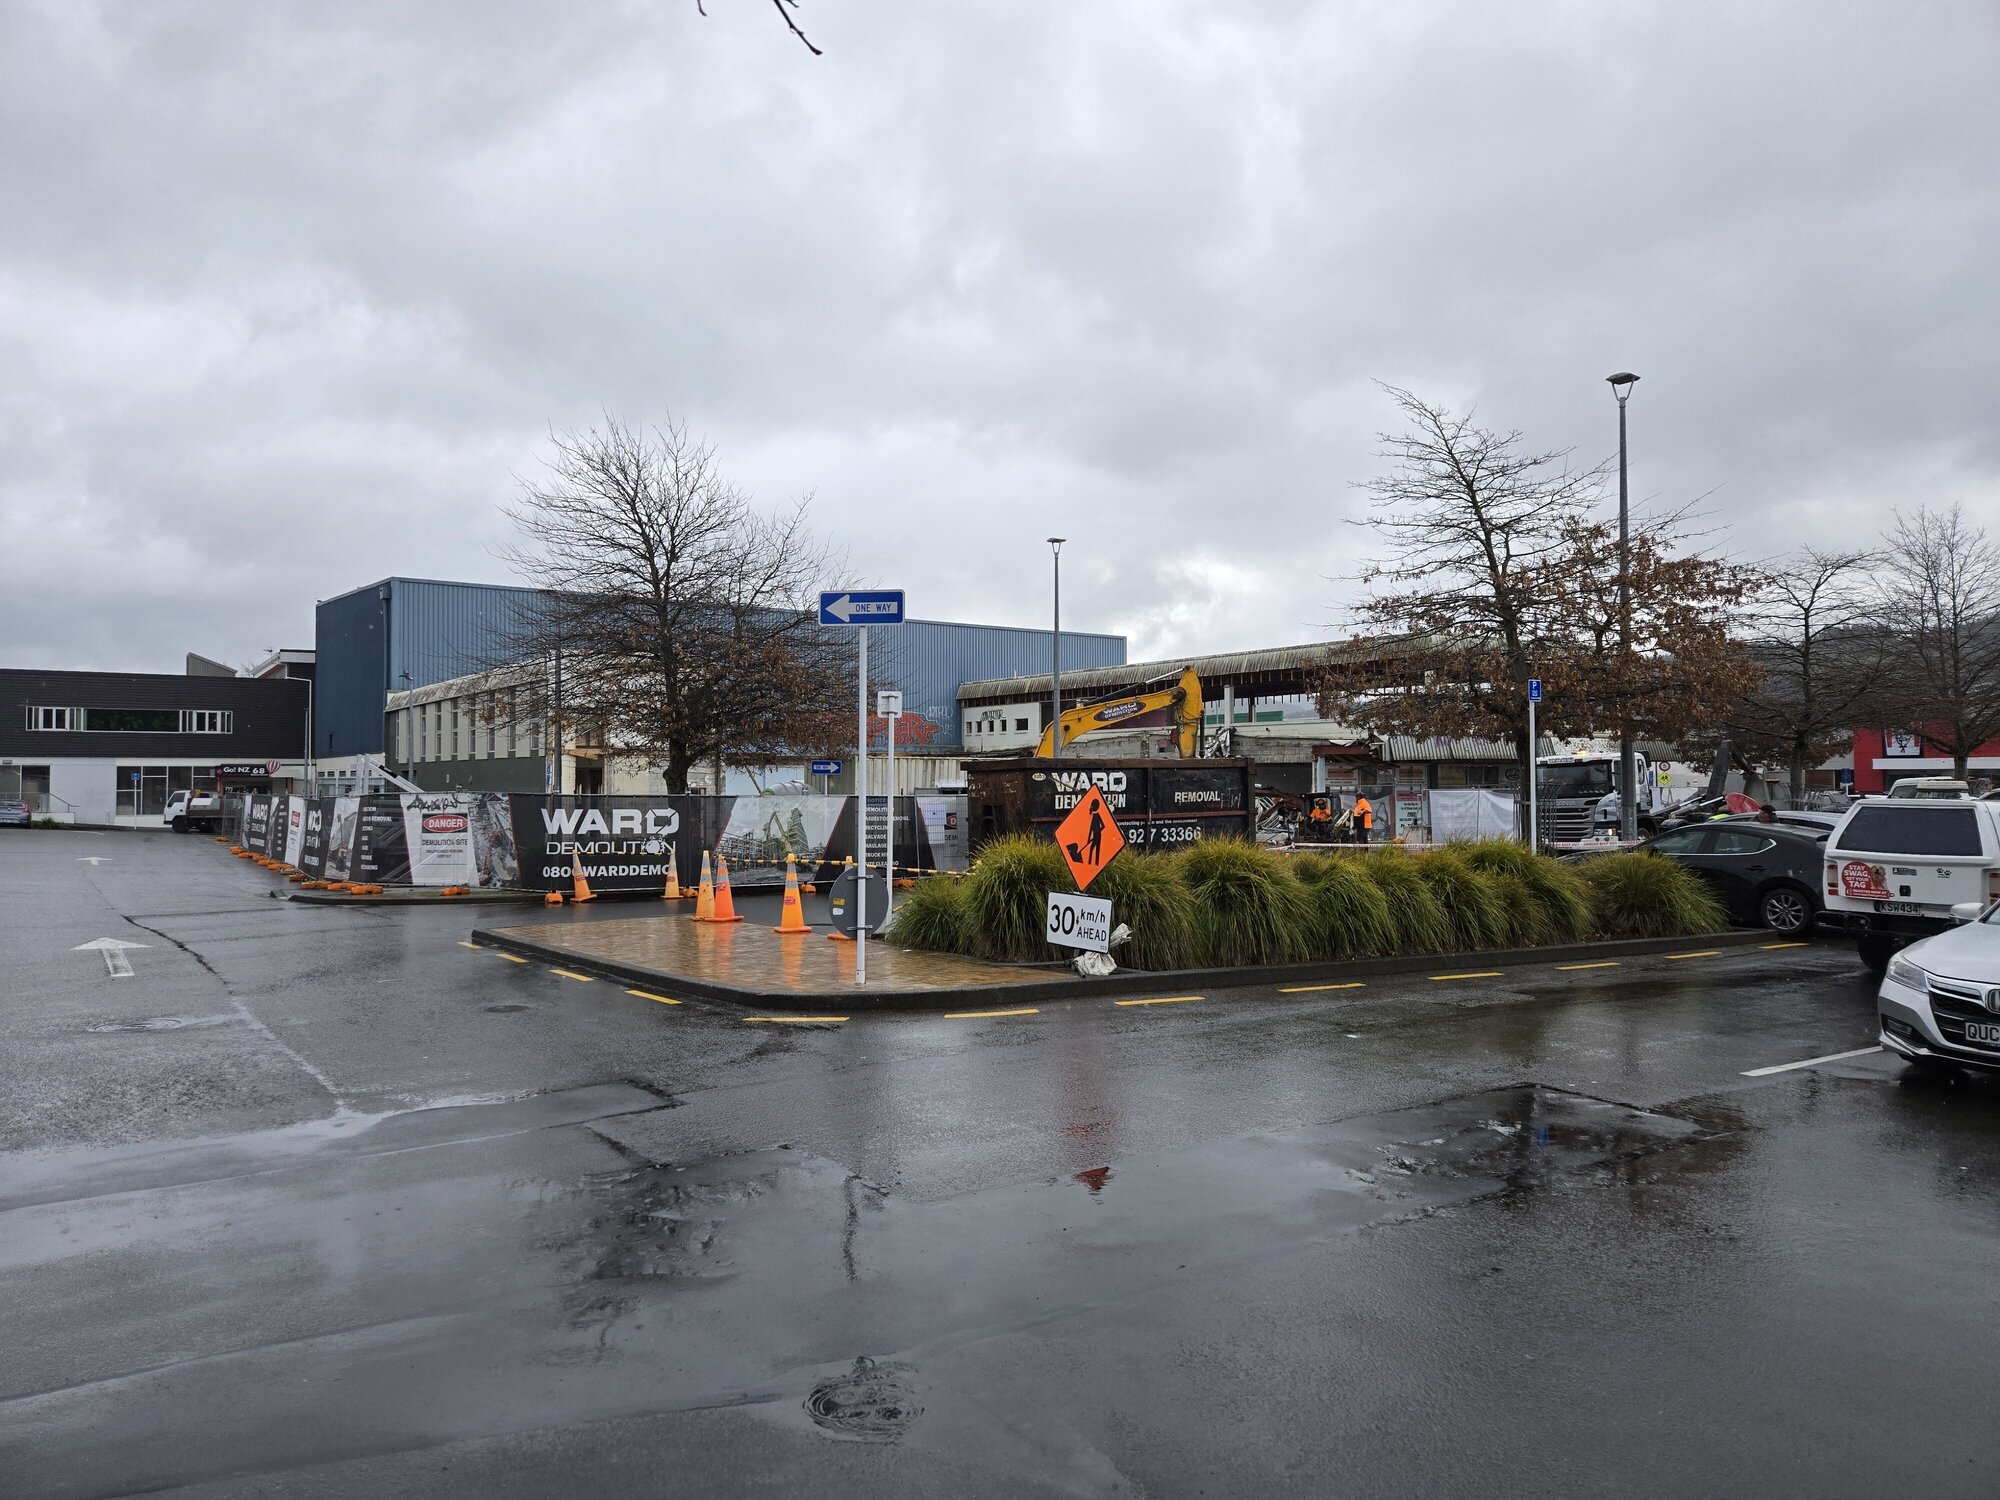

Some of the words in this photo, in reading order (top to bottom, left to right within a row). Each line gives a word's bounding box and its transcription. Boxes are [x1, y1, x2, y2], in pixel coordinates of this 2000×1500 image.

[855, 603, 871, 613] ONE
[875, 603, 892, 612] WAY
[1532, 681, 1538, 690] P
[1051, 771, 1127, 792] WARD
[1174, 790, 1221, 803] REMOVAL
[428, 818, 463, 828] DANGER
[541, 807, 680, 835] WARD
[455, 838, 468, 846] SITE
[542, 866, 576, 878] 080
[1844, 869, 1871, 878] SWAG,
[1849, 880, 1866, 889] TAG
[1881, 901, 1919, 914] KSW434
[1049, 904, 1075, 935] 30
[1080, 908, 1106, 924] km/h
[1076, 926, 1107, 942] AHEAD
[1967, 1024, 2000, 1042] QUC
